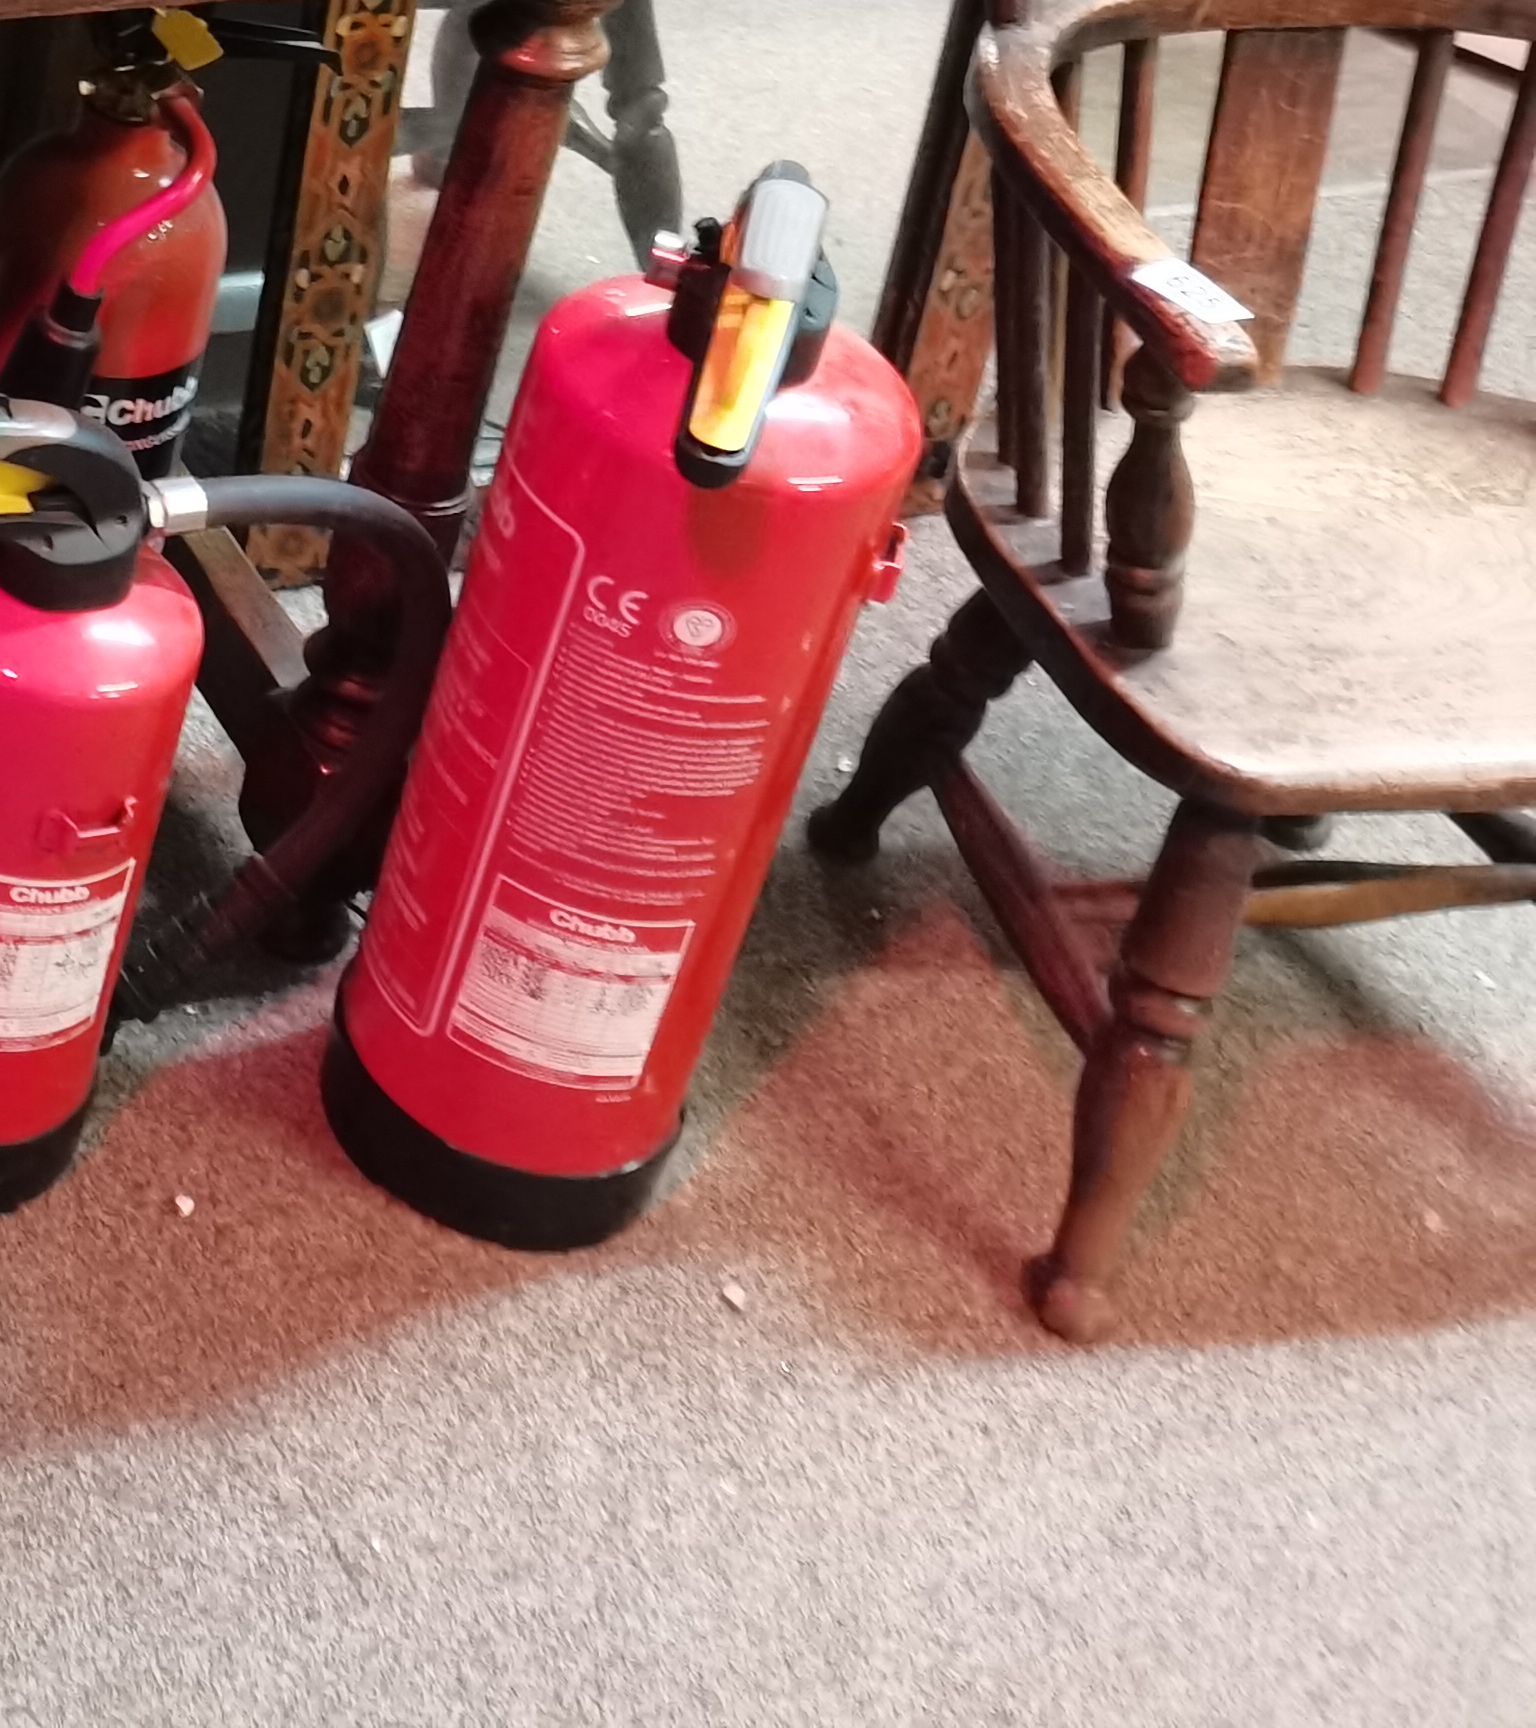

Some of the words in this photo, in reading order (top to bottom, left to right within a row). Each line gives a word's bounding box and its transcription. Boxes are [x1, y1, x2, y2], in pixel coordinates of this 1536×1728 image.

[1166, 275, 1221, 309] 625
[9, 885, 91, 905] Chubb
[549, 908, 637, 944] Chubb
